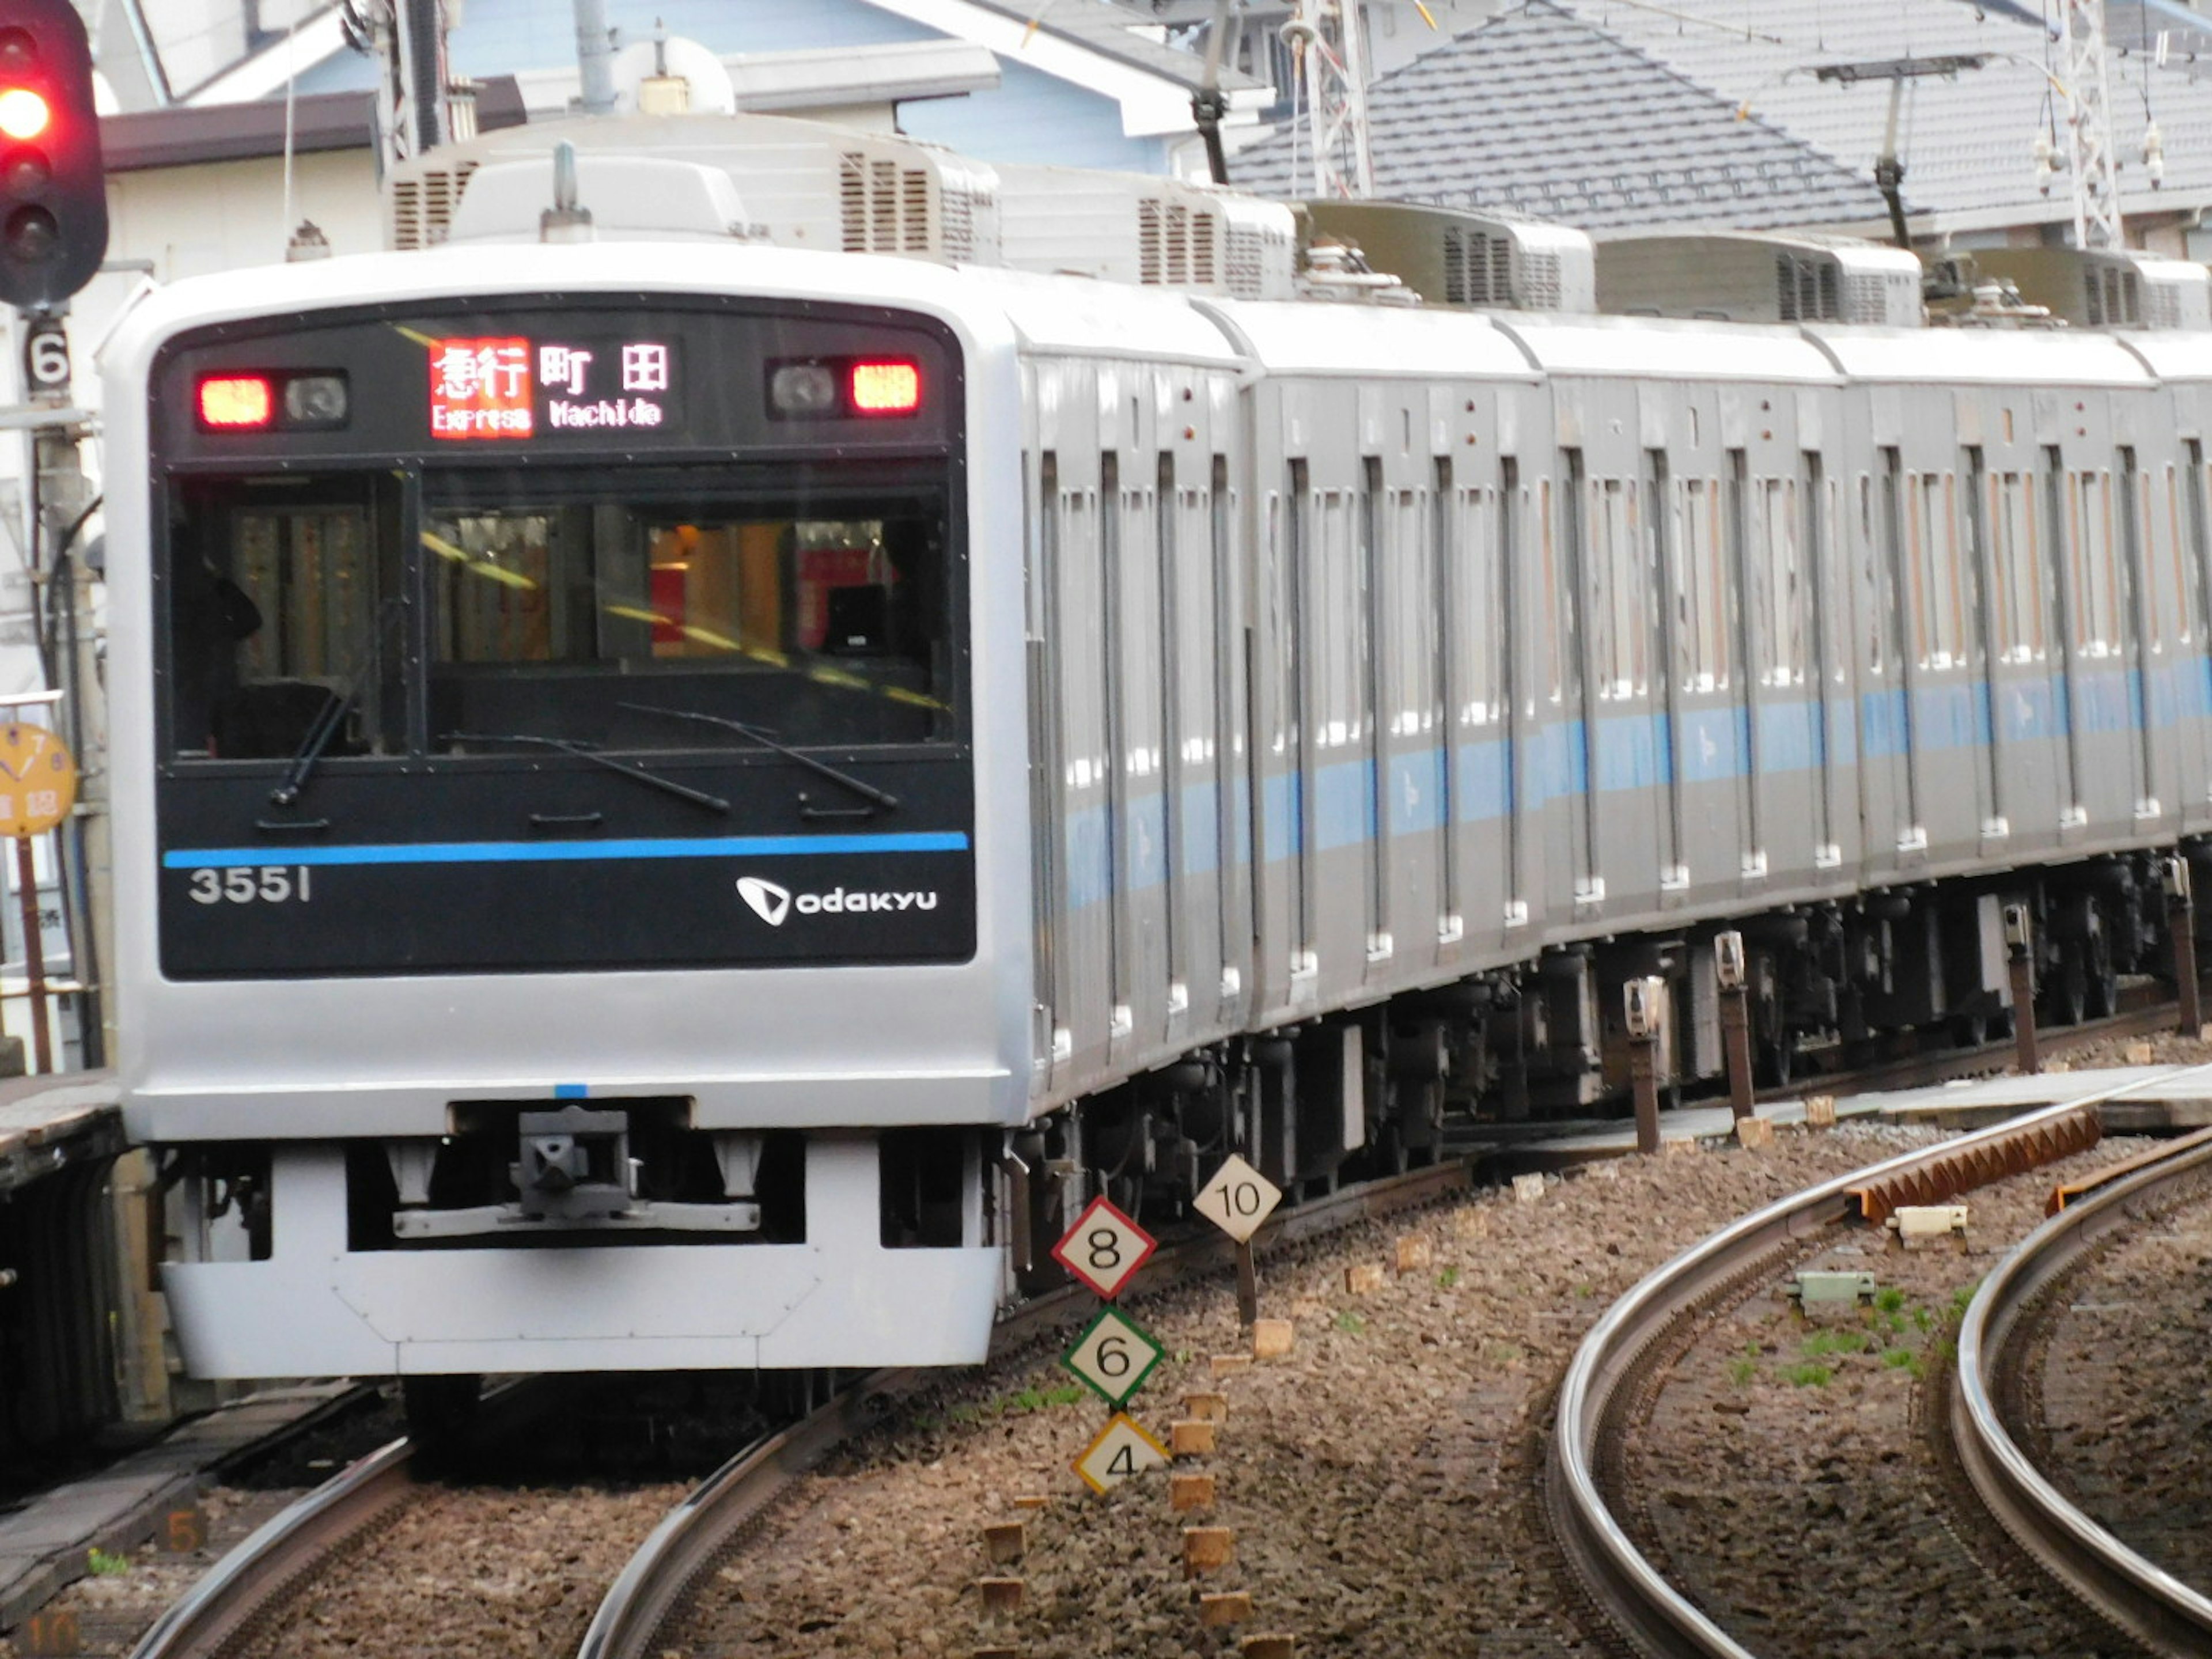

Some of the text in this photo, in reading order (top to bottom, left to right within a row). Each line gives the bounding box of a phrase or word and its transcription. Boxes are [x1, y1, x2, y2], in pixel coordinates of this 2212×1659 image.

[31, 333, 68, 384] 6
[433, 344, 667, 399] 急行 町田
[433, 397, 661, 430] Express Machida
[188, 865, 310, 904] 3551
[796, 887, 937, 914] odakyu
[1215, 1182, 1260, 1217] 10
[1088, 1229, 1120, 1270] 8
[1096, 1336, 1130, 1377] 6
[1106, 1445, 1138, 1475] 4
[168, 1512, 198, 1552] 5
